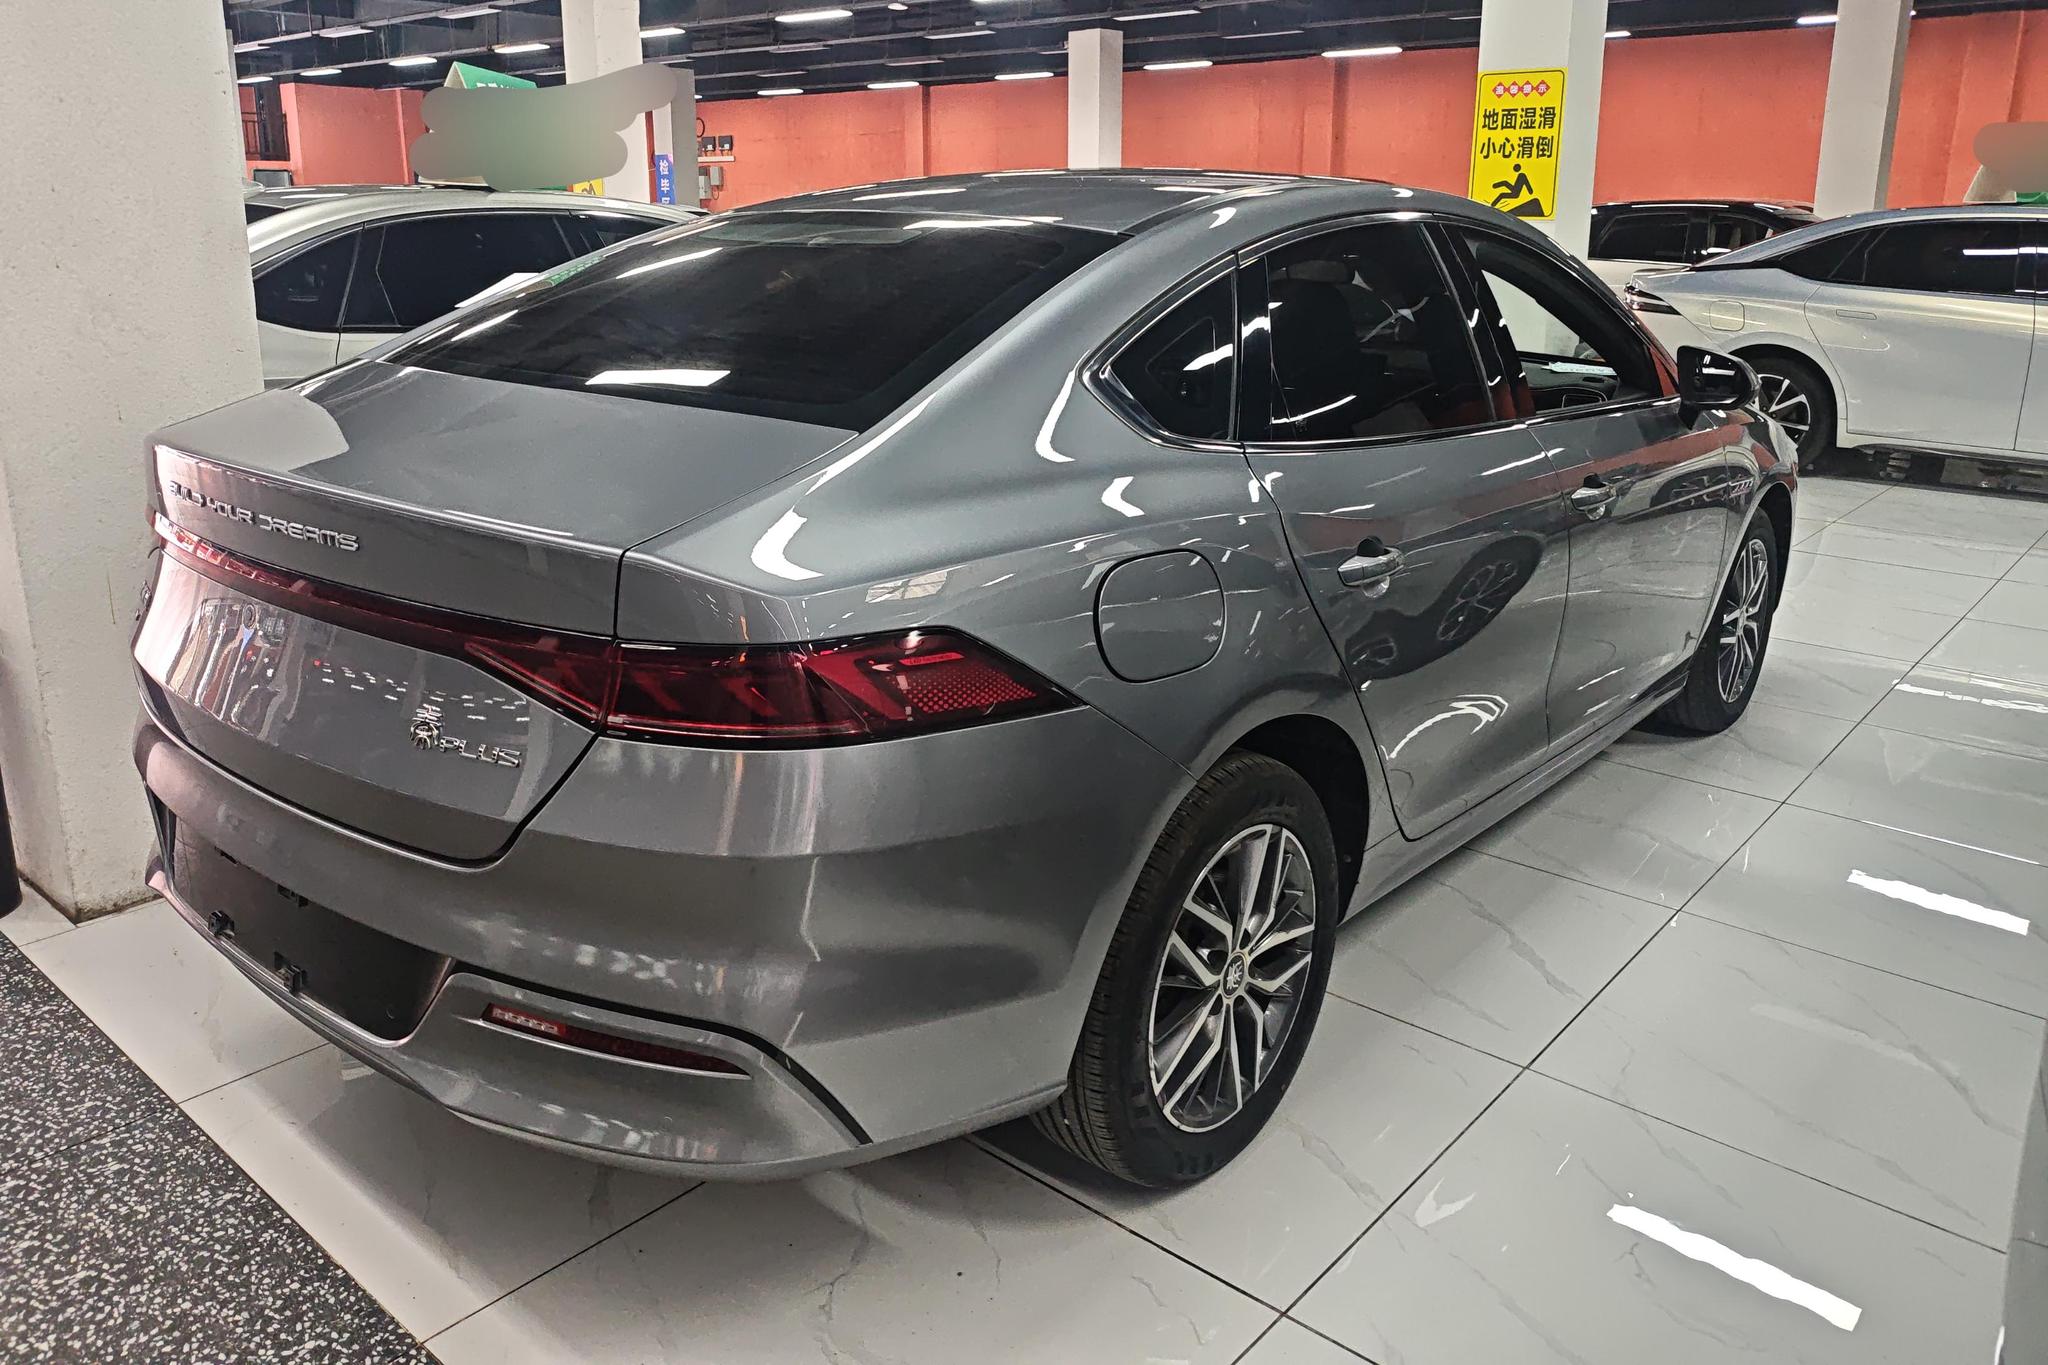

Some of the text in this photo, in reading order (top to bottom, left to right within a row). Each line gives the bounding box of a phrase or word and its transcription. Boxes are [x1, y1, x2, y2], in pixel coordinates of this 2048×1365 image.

[1482, 106, 1556, 130] 地面湿滑
[1480, 136, 1554, 159] 小心滑倒
[169, 480, 359, 552] BUILD YOUR DREAMS
[440, 736, 523, 768] PLUS
